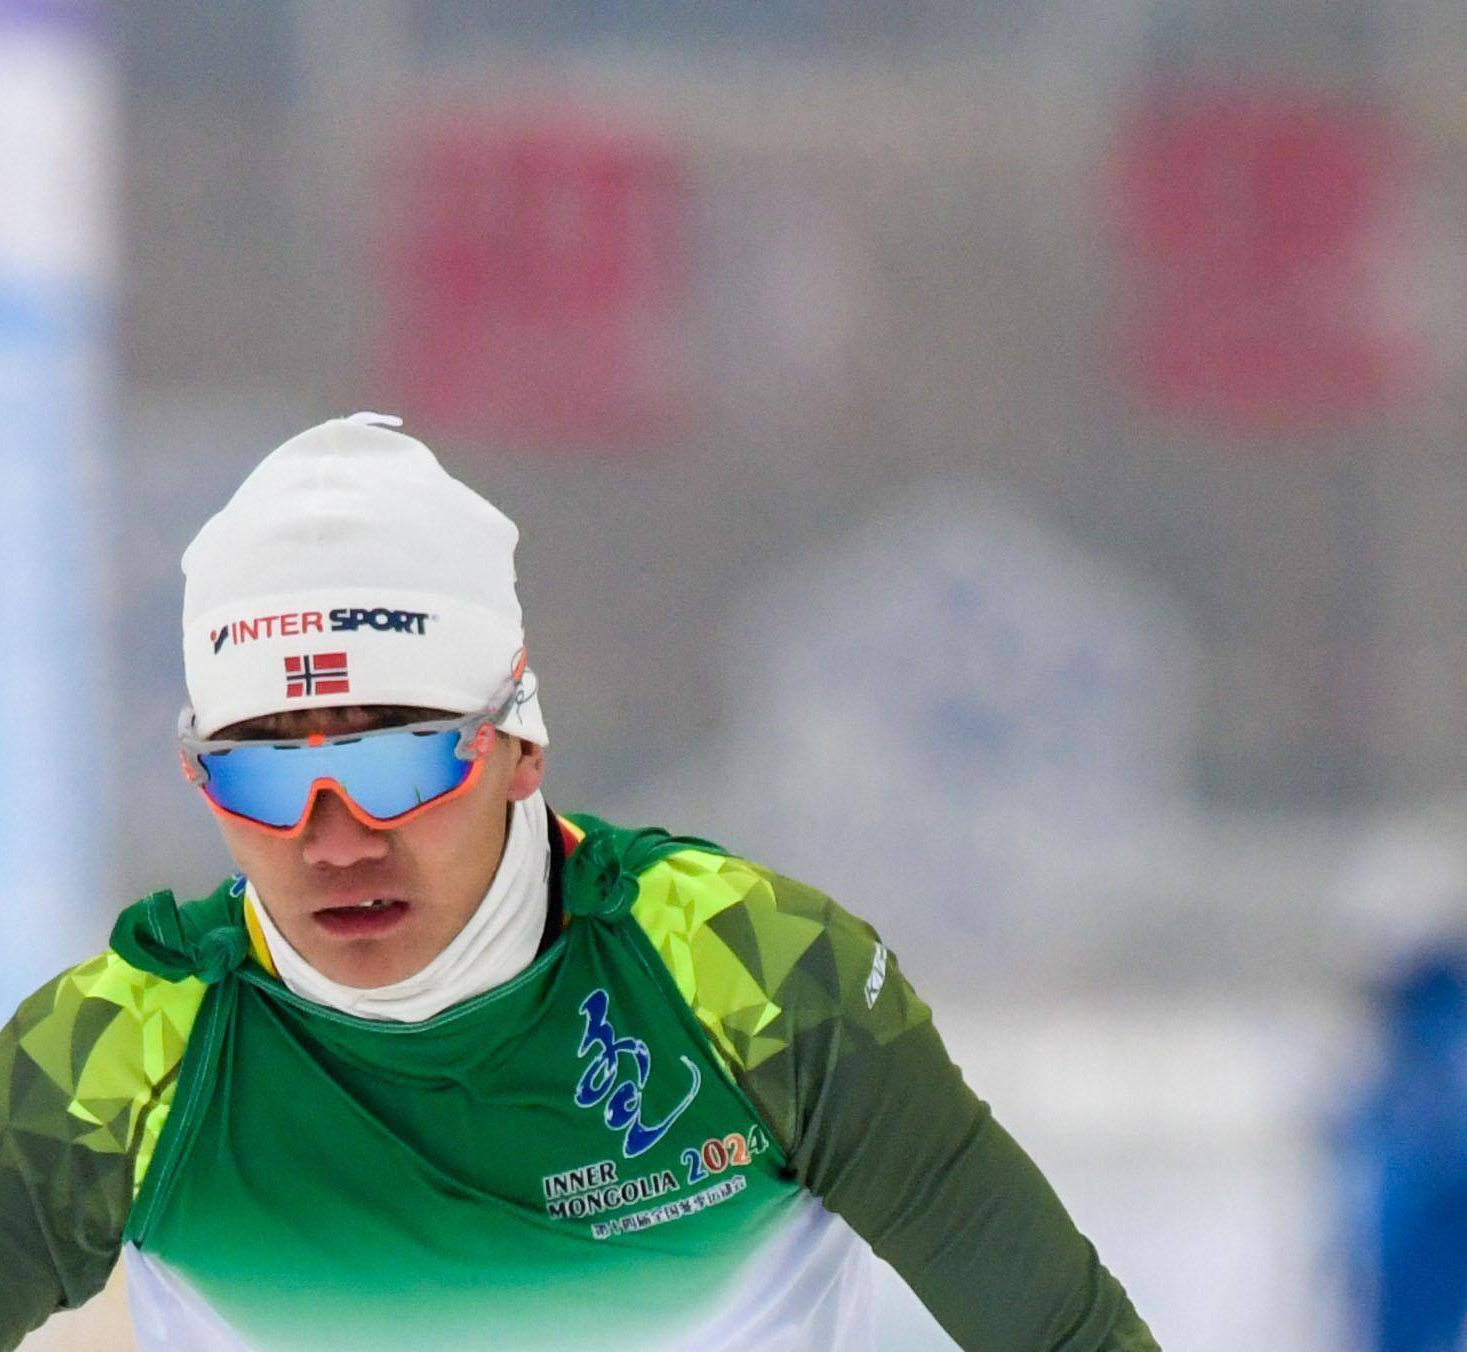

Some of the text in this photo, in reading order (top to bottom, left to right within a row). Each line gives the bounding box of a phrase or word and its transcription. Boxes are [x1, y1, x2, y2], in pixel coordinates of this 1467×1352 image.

[543, 1160, 618, 1199] INNER
[546, 1124, 769, 1220] MONGOLIA 2024
